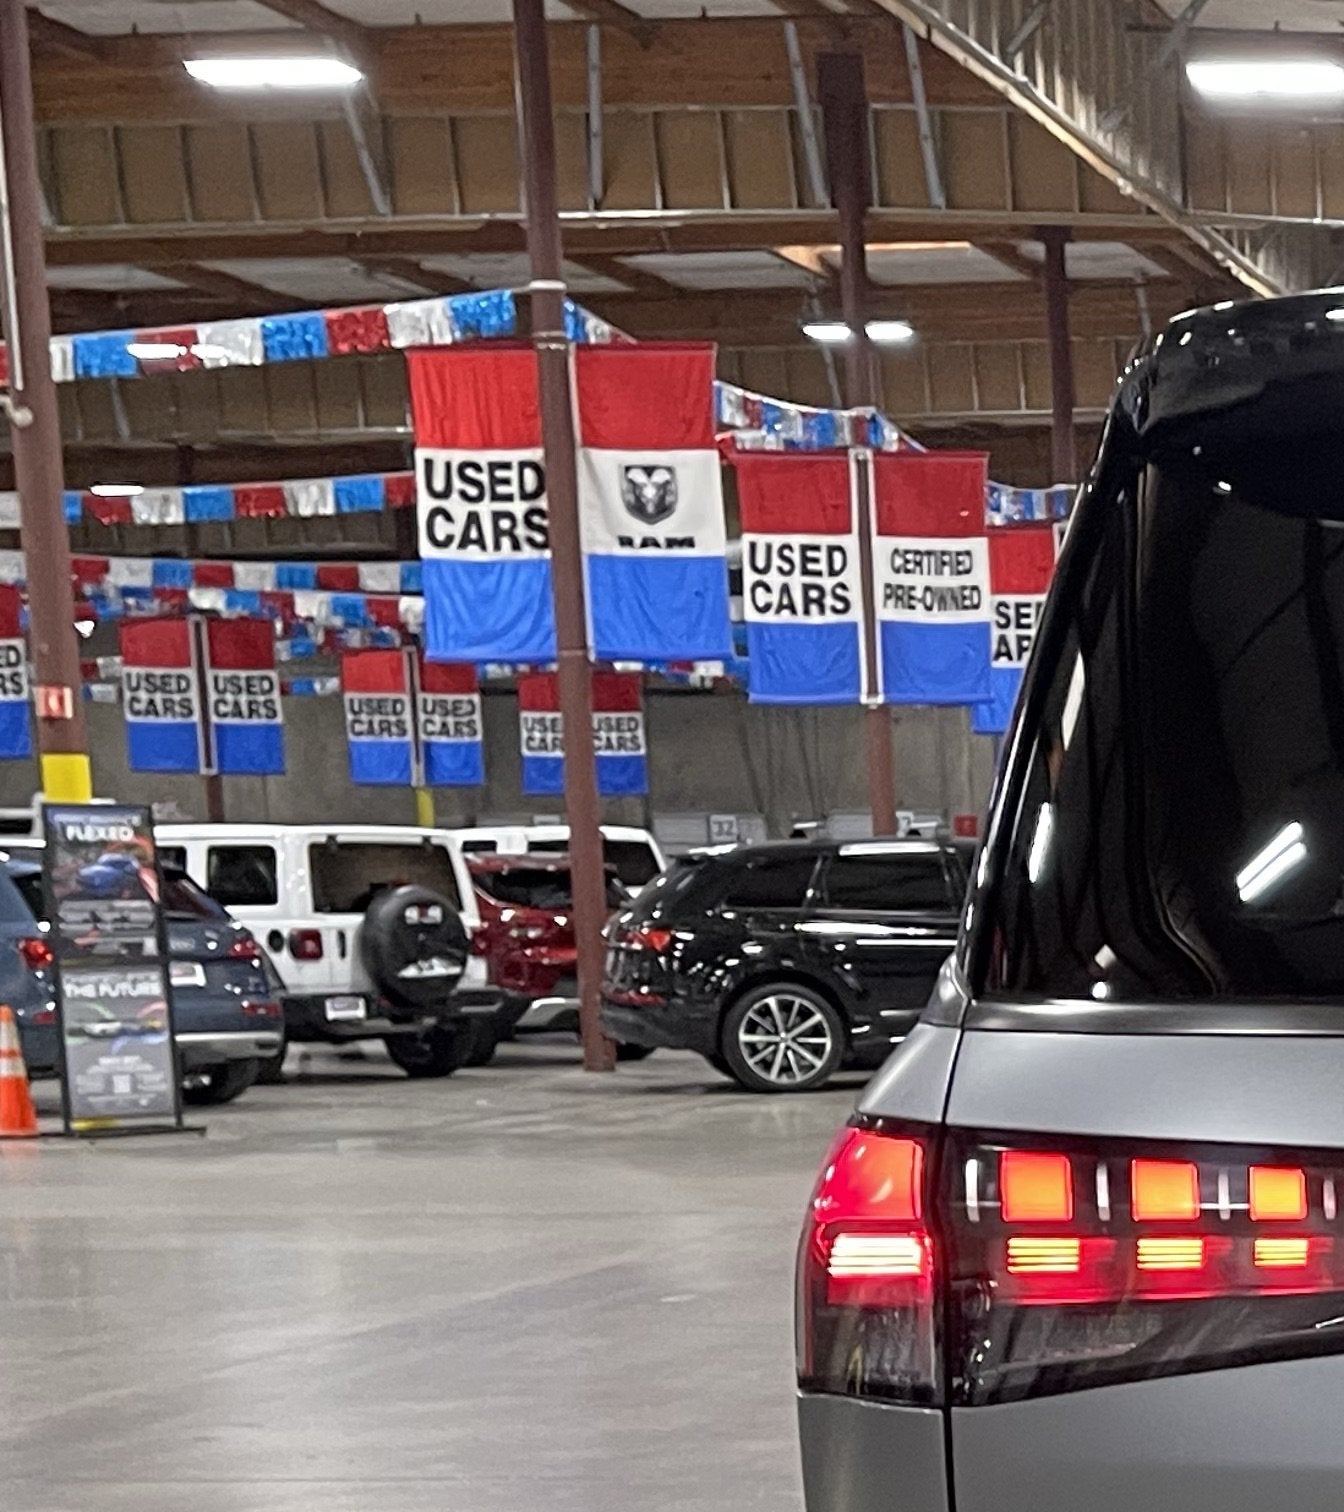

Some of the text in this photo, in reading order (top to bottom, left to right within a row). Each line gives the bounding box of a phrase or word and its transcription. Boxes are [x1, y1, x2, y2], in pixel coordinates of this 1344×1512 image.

[424, 457, 546, 504] USED
[425, 506, 550, 552] CARS
[617, 534, 696, 550] RAM
[748, 541, 848, 578] USED
[890, 547, 973, 576] CERTIFIED
[749, 582, 851, 617] CARS
[882, 583, 981, 612] PRE-OWNED
[994, 600, 1042, 630] SE
[126, 672, 191, 694] USED
[213, 674, 275, 696] USED
[128, 697, 195, 718] CARS
[213, 697, 279, 720] CARS
[349, 698, 406, 716] USED
[421, 698, 477, 717] USED
[349, 717, 408, 738] CARS
[422, 717, 479, 738] CARS
[522, 716, 562, 733] USE
